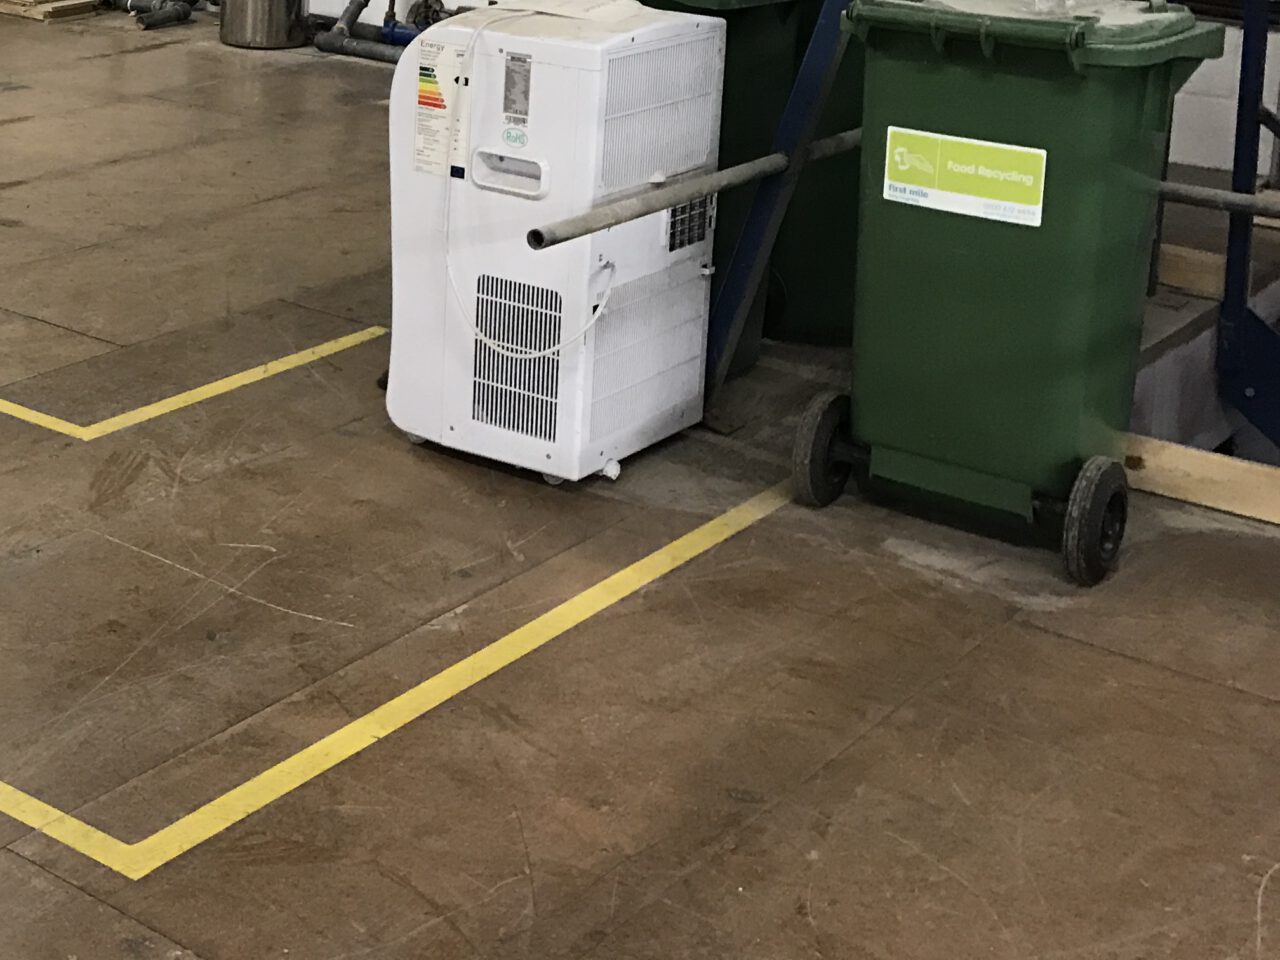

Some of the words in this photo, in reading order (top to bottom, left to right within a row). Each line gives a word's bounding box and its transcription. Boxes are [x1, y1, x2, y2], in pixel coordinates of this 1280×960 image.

[420, 41, 445, 52] Energy
[946, 159, 976, 176] Food
[978, 166, 1034, 187] Recycling
[888, 183, 907, 195] first
[909, 188, 929, 199] mile
